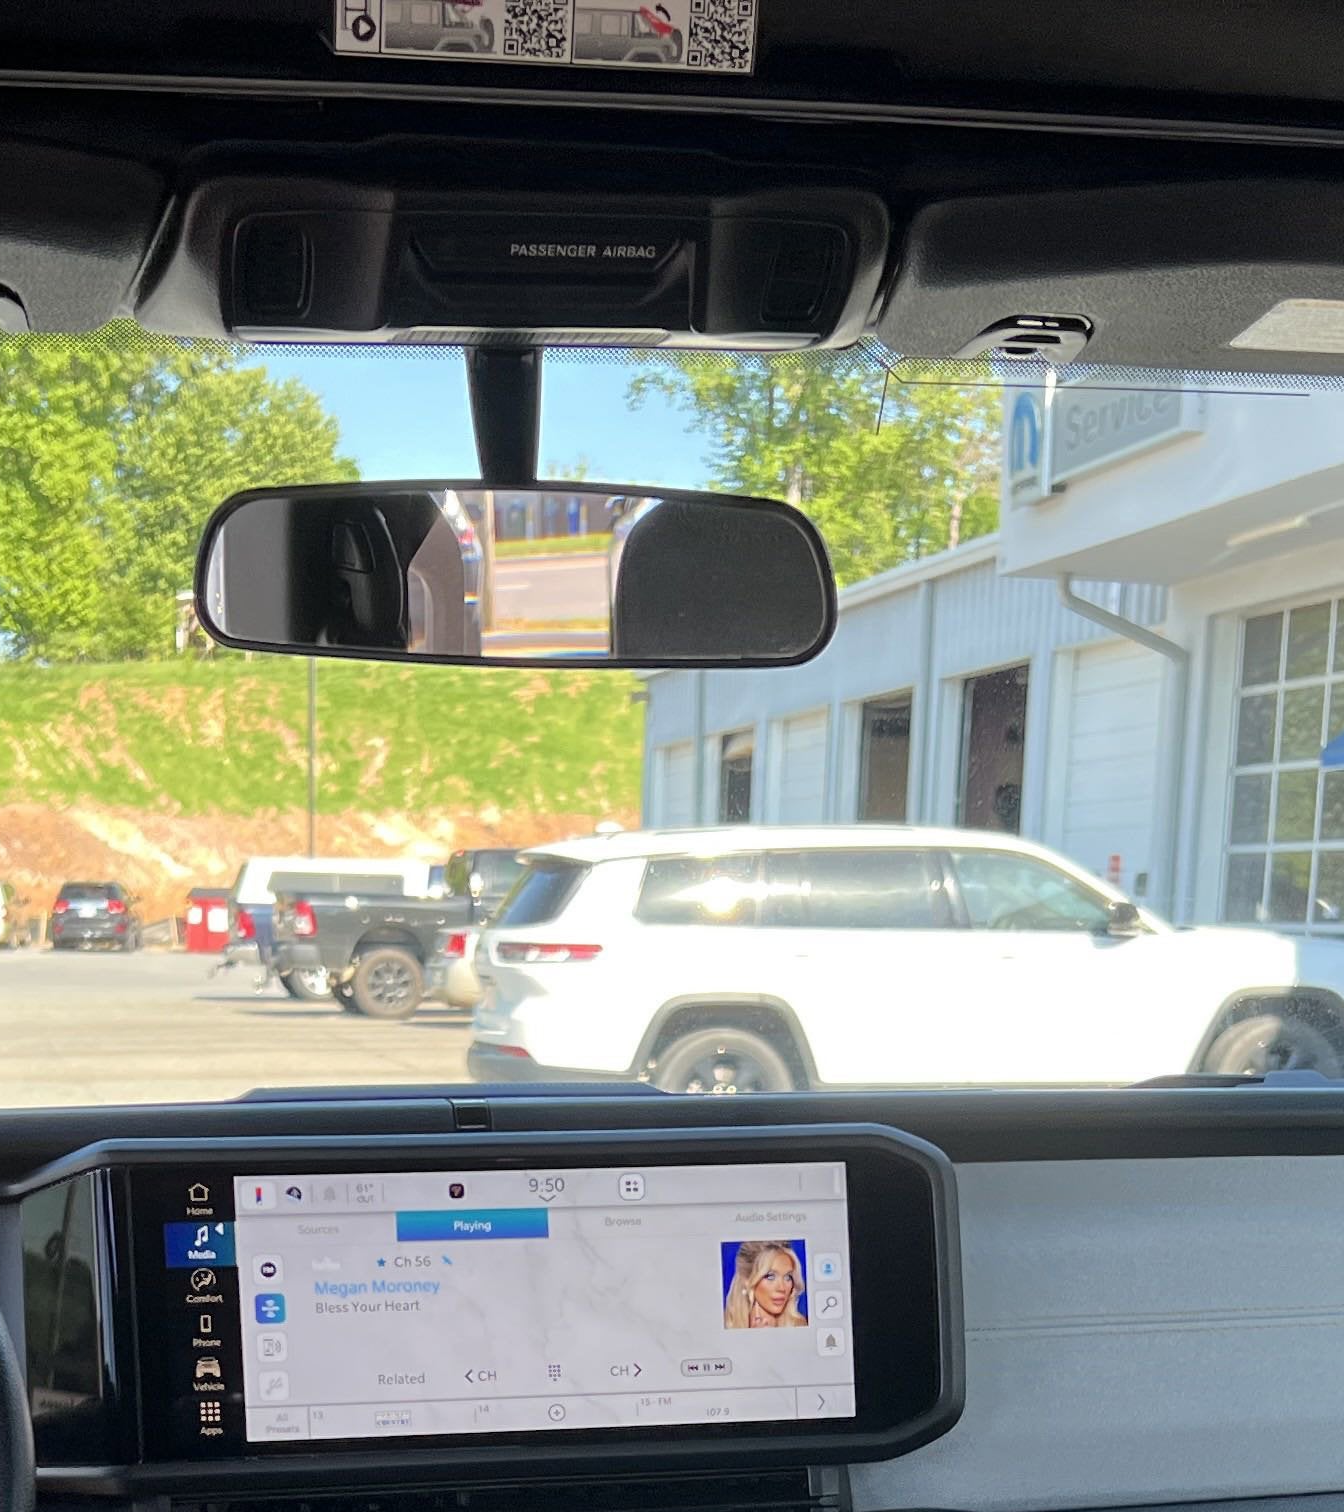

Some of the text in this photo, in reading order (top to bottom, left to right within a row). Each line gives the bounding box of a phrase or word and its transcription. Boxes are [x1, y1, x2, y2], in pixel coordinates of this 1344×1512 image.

[510, 243, 656, 259] PASSENGER AIRBAG
[1065, 388, 1171, 452] Service
[528, 1178, 565, 1194] 9:50
[186, 1206, 214, 1217] Home
[735, 1210, 807, 1224] Audio Settings
[453, 1219, 492, 1233] Playing
[604, 1216, 642, 1227] Browse
[298, 1224, 339, 1236] Sources
[187, 1250, 217, 1260] Media
[394, 1256, 432, 1268] Ch 56
[314, 1280, 441, 1298] Megan Moroney
[186, 1294, 224, 1304] Comfort
[316, 1300, 421, 1314] Bless Your Heart
[192, 1338, 222, 1348] Phone
[477, 1370, 497, 1382] CH
[610, 1364, 629, 1377] CH
[377, 1373, 425, 1386] Related
[193, 1382, 225, 1392] Vehicle
[200, 1426, 224, 1437] Apps
[265, 1424, 300, 1435] Presets
